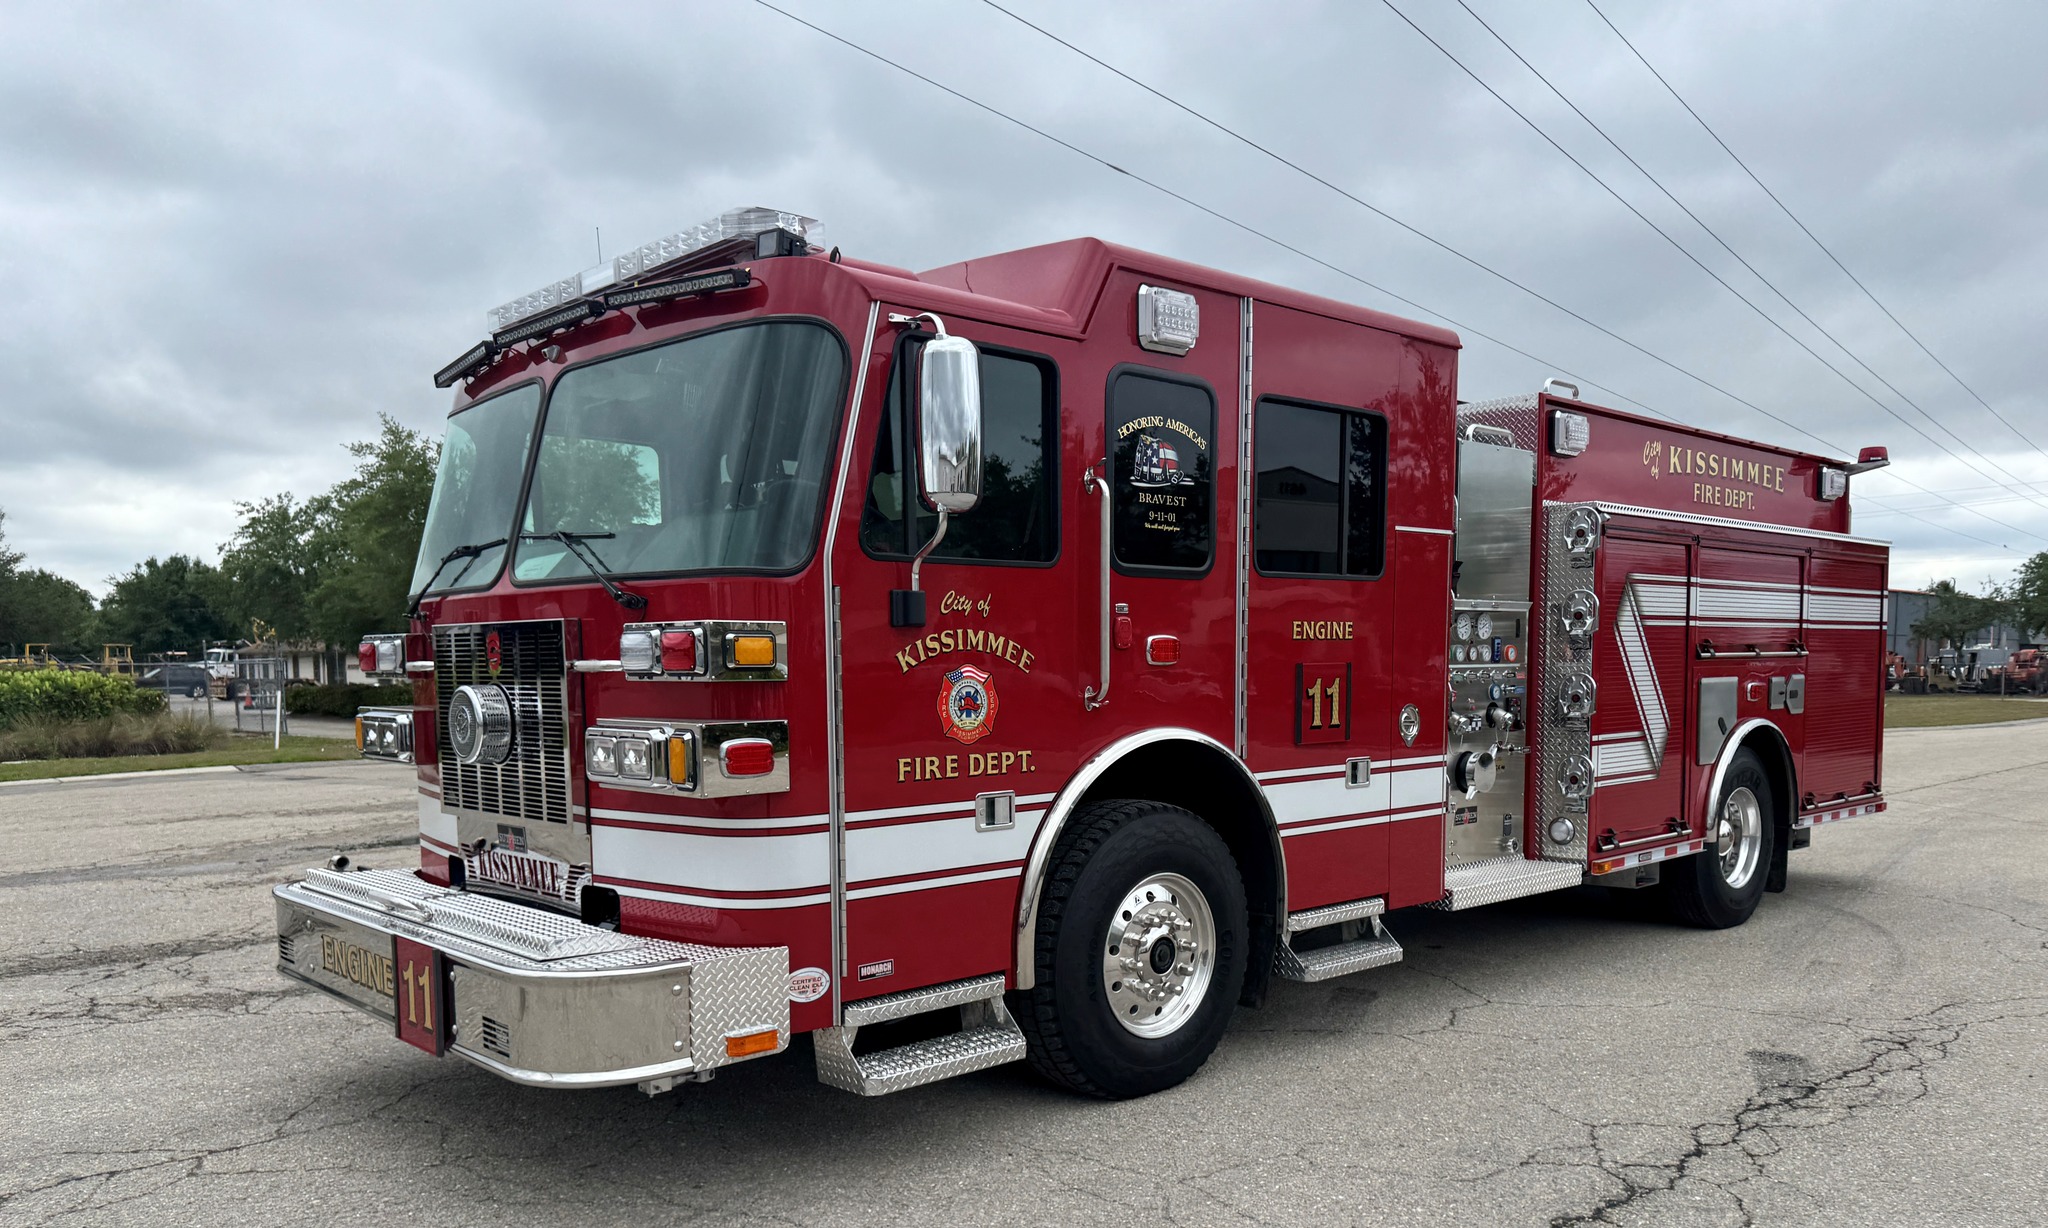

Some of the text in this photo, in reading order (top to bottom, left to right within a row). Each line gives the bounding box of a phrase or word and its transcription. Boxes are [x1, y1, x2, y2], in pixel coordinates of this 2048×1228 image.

[1117, 415, 1207, 450] HONORING AMERICA'S
[1643, 440, 1662, 480] City of
[1669, 445, 1785, 493] KISSIMMEE
[1139, 492, 1187, 507] BRAVEST
[1693, 482, 1755, 511] FIRE DEPT.
[1149, 511, 1176, 522] 9-11-01
[940, 590, 992, 617] City of
[1292, 621, 1353, 640] ENGINE
[895, 629, 1035, 674] KISSIMMEE
[1307, 678, 1340, 729] 11
[897, 750, 1036, 783] FIRE DEPT.
[479, 849, 561, 893] KISSIMMEE
[321, 934, 394, 999] ENGINE
[861, 962, 892, 977] MONARCH
[403, 960, 434, 1034] 11
[789, 984, 810, 992] CLEAN
